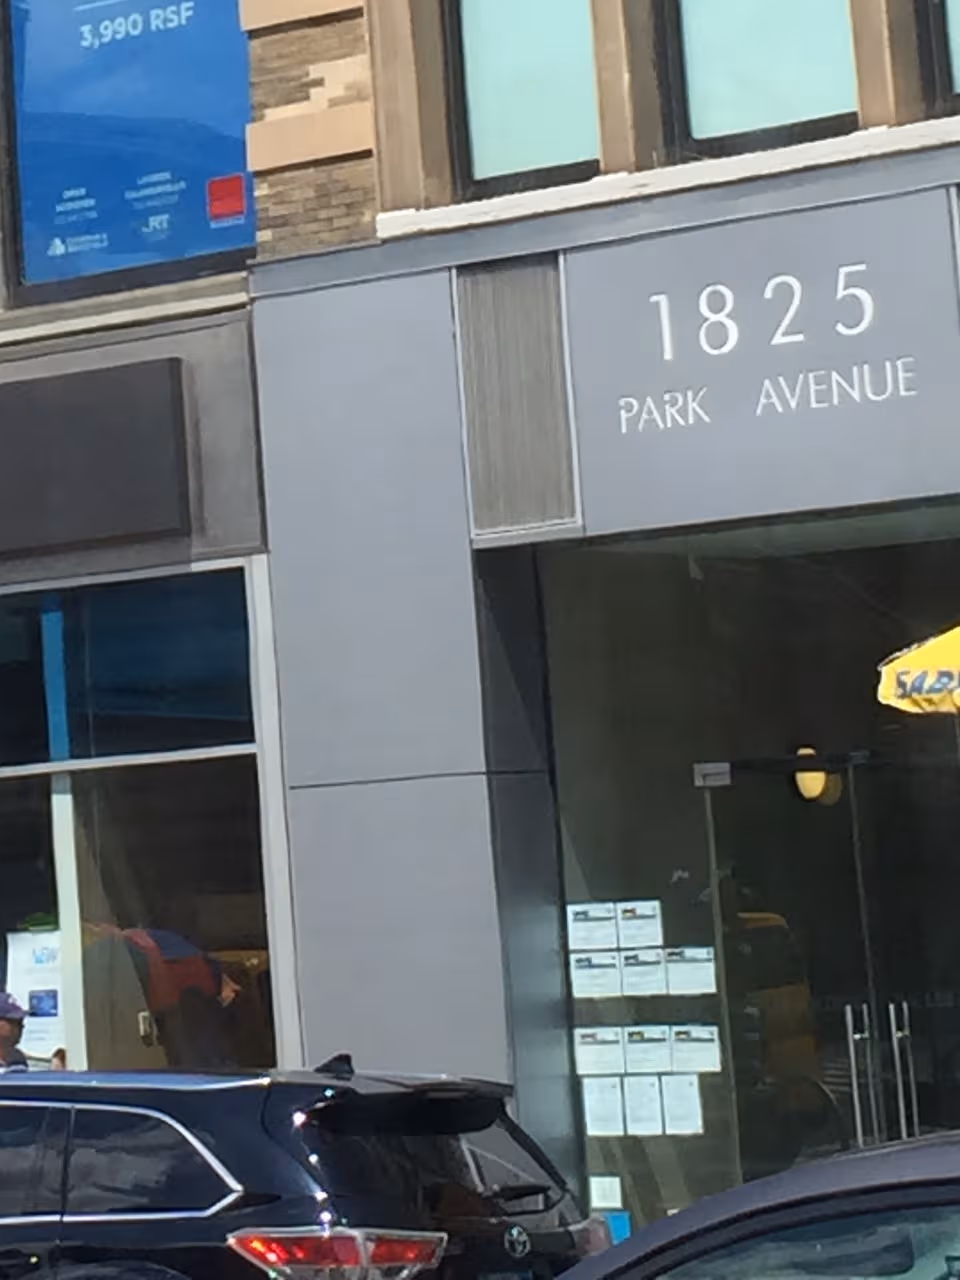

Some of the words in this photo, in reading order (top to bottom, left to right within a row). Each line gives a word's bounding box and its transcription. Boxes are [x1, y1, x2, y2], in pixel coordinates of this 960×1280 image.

[80, 13, 143, 48] 3,990
[150, 1, 195, 31] RSF
[649, 263, 876, 361] 1825
[618, 387, 712, 435] PARK
[755, 356, 919, 417] AVENUE
